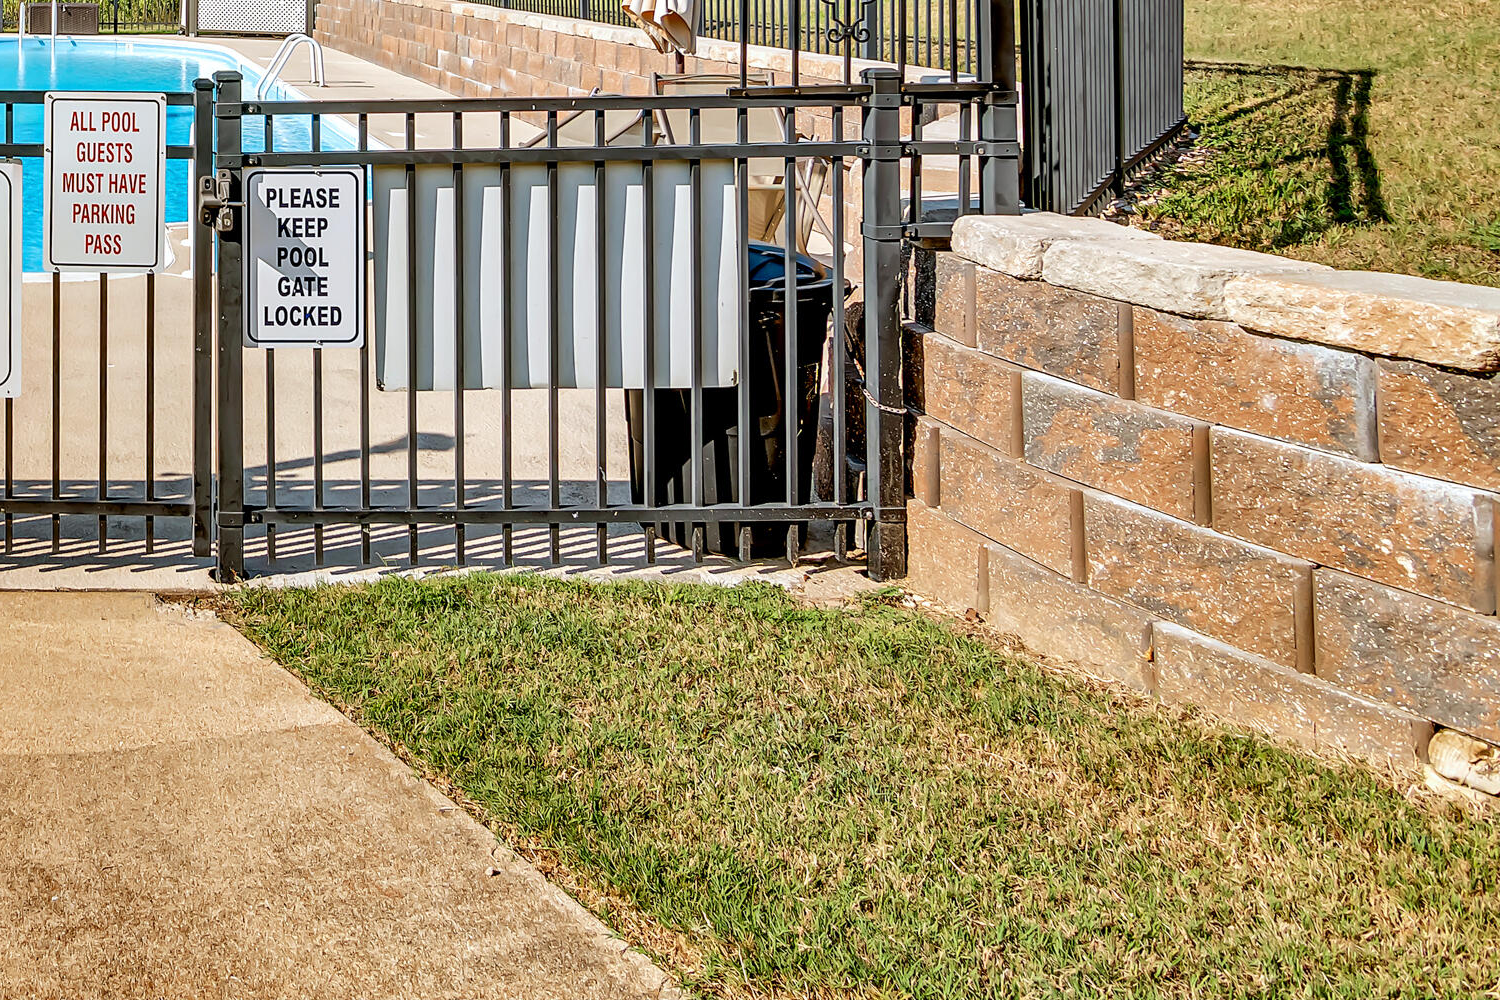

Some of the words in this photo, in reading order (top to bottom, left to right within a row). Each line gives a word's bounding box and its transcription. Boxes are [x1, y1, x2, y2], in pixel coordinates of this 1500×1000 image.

[70, 111, 96, 132] ALL
[101, 111, 139, 133] POOL
[76, 142, 133, 163] GUESTS
[62, 172, 104, 193] MUST
[108, 173, 146, 194] HAVE
[266, 187, 340, 209] PLEASE
[72, 203, 135, 225] PARKING
[277, 217, 328, 238] KEEP
[85, 234, 122, 255] PASS
[277, 244, 329, 268] POOL
[277, 276, 328, 297] GATE
[264, 305, 342, 327] LOCKED
